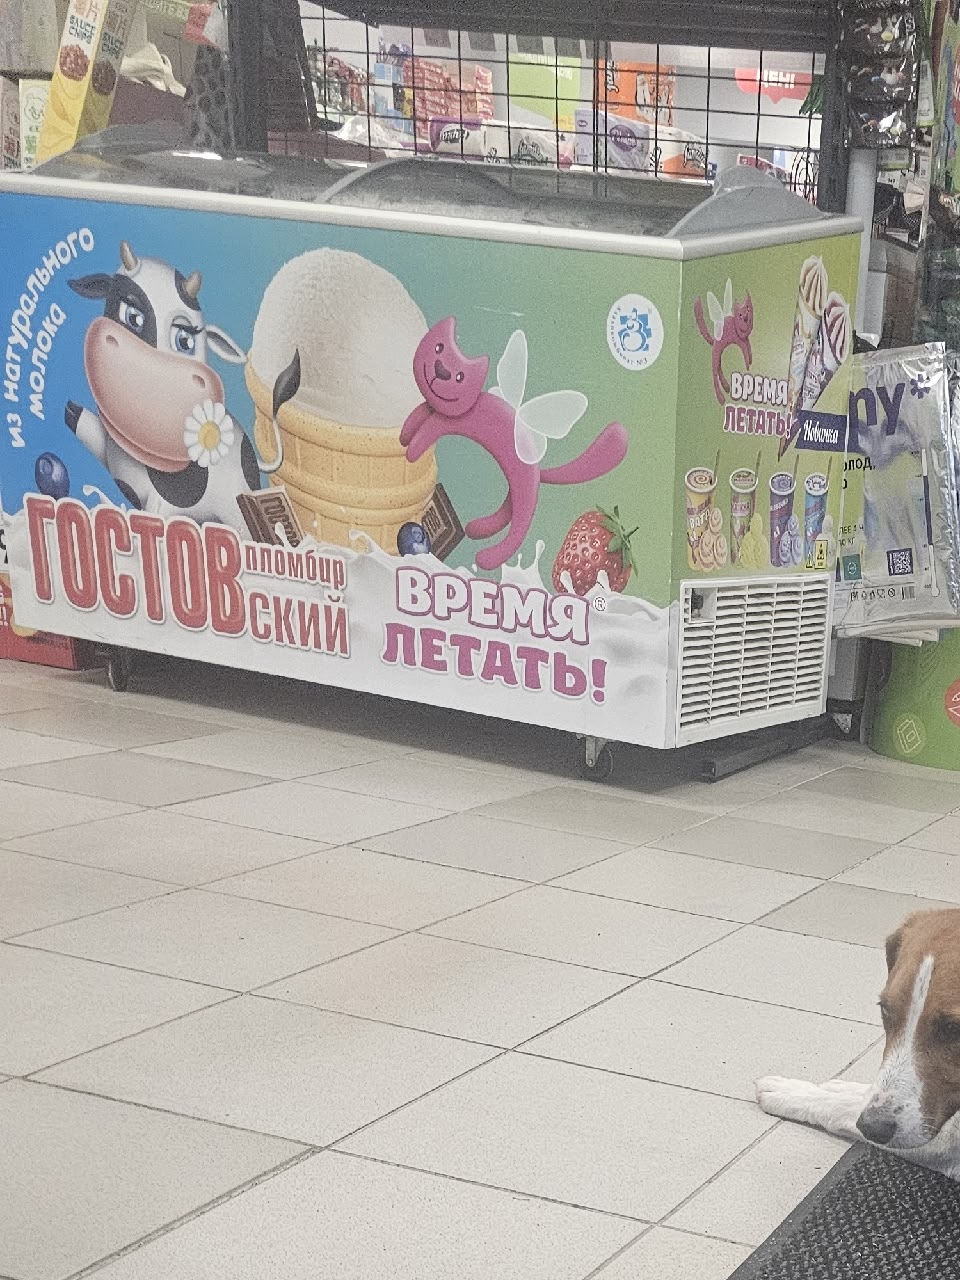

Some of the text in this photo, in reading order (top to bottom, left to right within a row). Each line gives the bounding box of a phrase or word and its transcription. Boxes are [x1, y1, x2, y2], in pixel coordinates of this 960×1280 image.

[4, 228, 95, 447] из натурального
[30, 303, 67, 420] молока
[723, 404, 793, 439] ЛЕТАТЬ!
[731, 371, 788, 406] ВРЕМЯ
[803, 419, 839, 444] Новинка
[25, 496, 247, 635] ГОСТОВ
[245, 544, 347, 590] пломбир
[396, 566, 590, 645] ВРЕМЯ
[382, 622, 608, 703] ЛЕТАТЬ!
